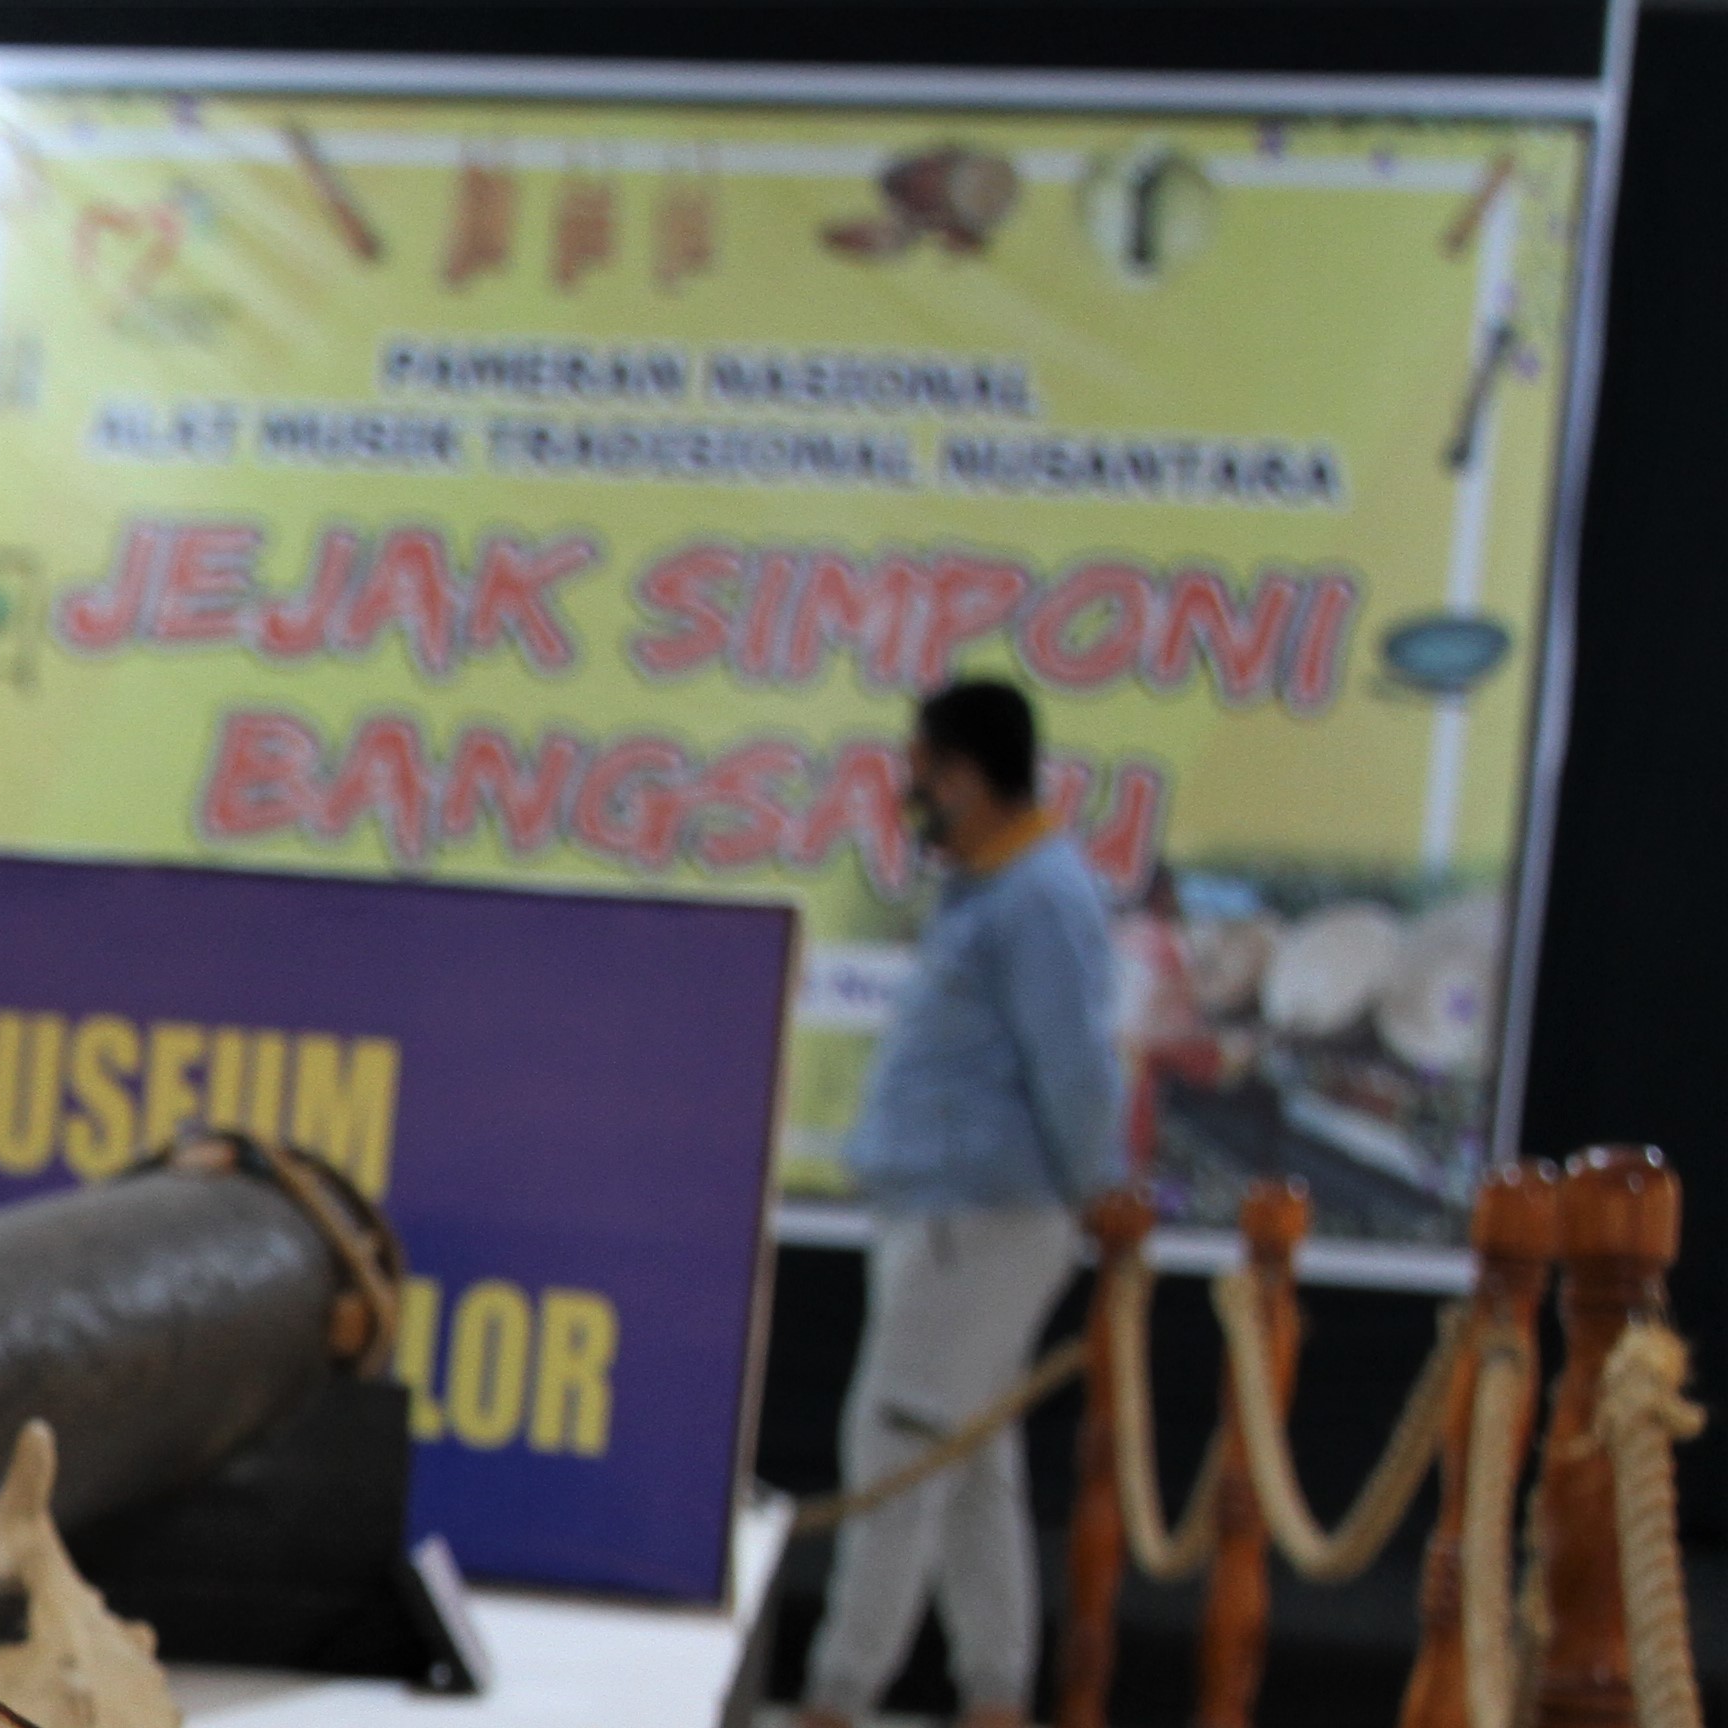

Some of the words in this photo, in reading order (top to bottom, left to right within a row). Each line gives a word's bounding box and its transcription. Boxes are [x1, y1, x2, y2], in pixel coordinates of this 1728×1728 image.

[382, 341, 688, 402] PAMERAN
[704, 352, 1032, 415] NASIONAL
[259, 408, 464, 468] MUSIK
[484, 415, 918, 490] TRADISIONAL
[938, 434, 1344, 505] NUSANTARA
[56, 518, 600, 680] JEJAK
[630, 542, 1360, 708] SIMPONI
[199, 710, 1166, 896] BANGSAU
